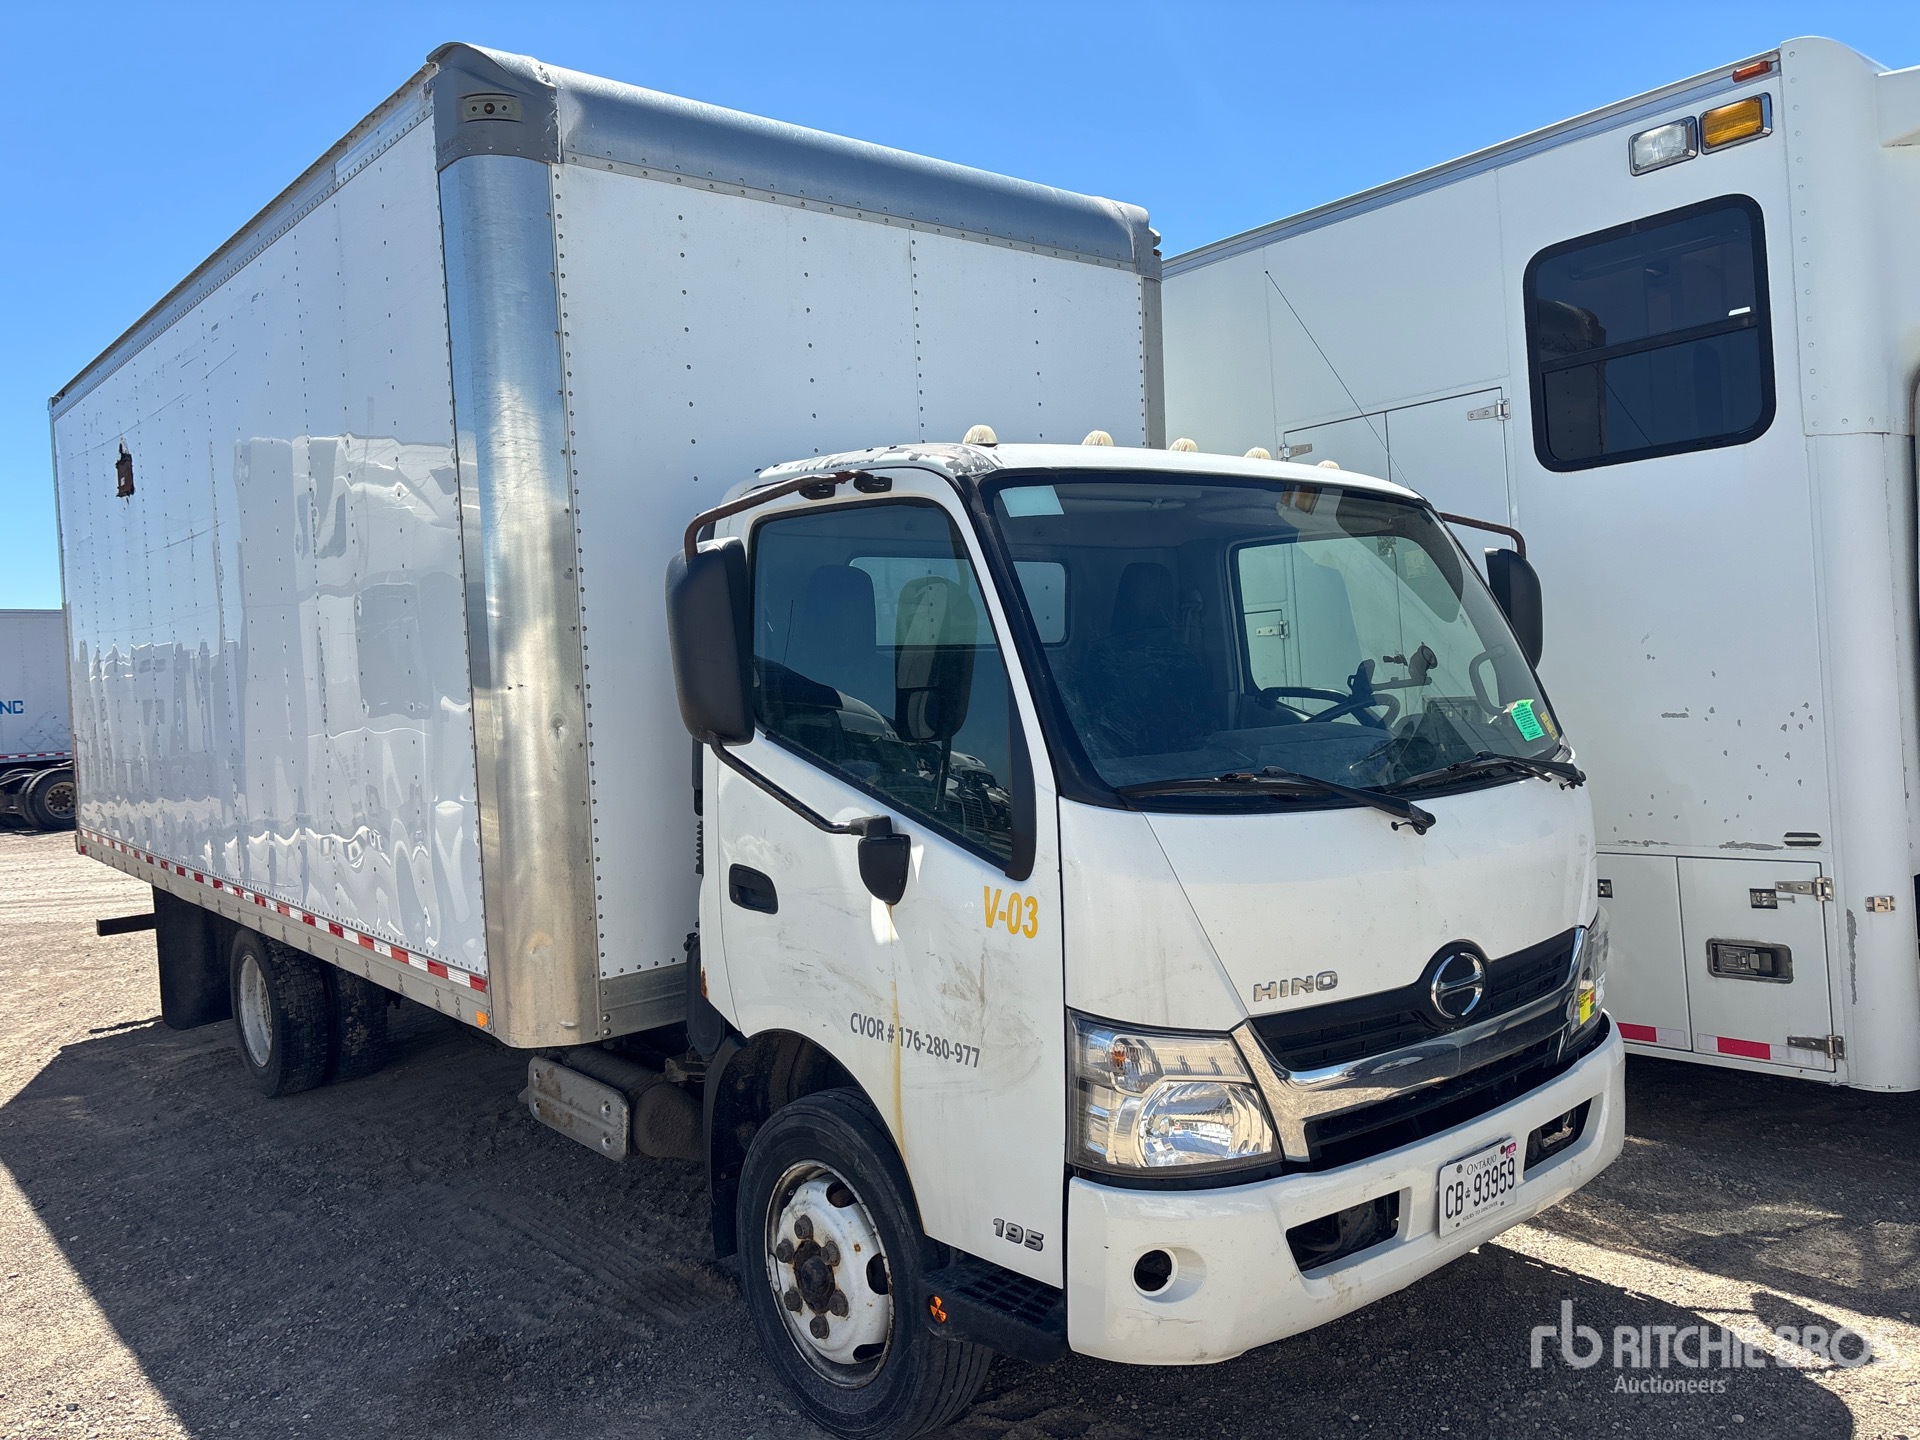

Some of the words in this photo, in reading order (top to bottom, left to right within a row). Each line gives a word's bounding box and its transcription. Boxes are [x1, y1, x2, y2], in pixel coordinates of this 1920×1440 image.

[983, 886, 1038, 939] V-03
[1253, 970, 1338, 1002] HINO
[850, 1012, 884, 1041] CVOR
[1466, 1154, 1497, 1175] ONTARIO
[992, 1217, 1044, 1252] 195
